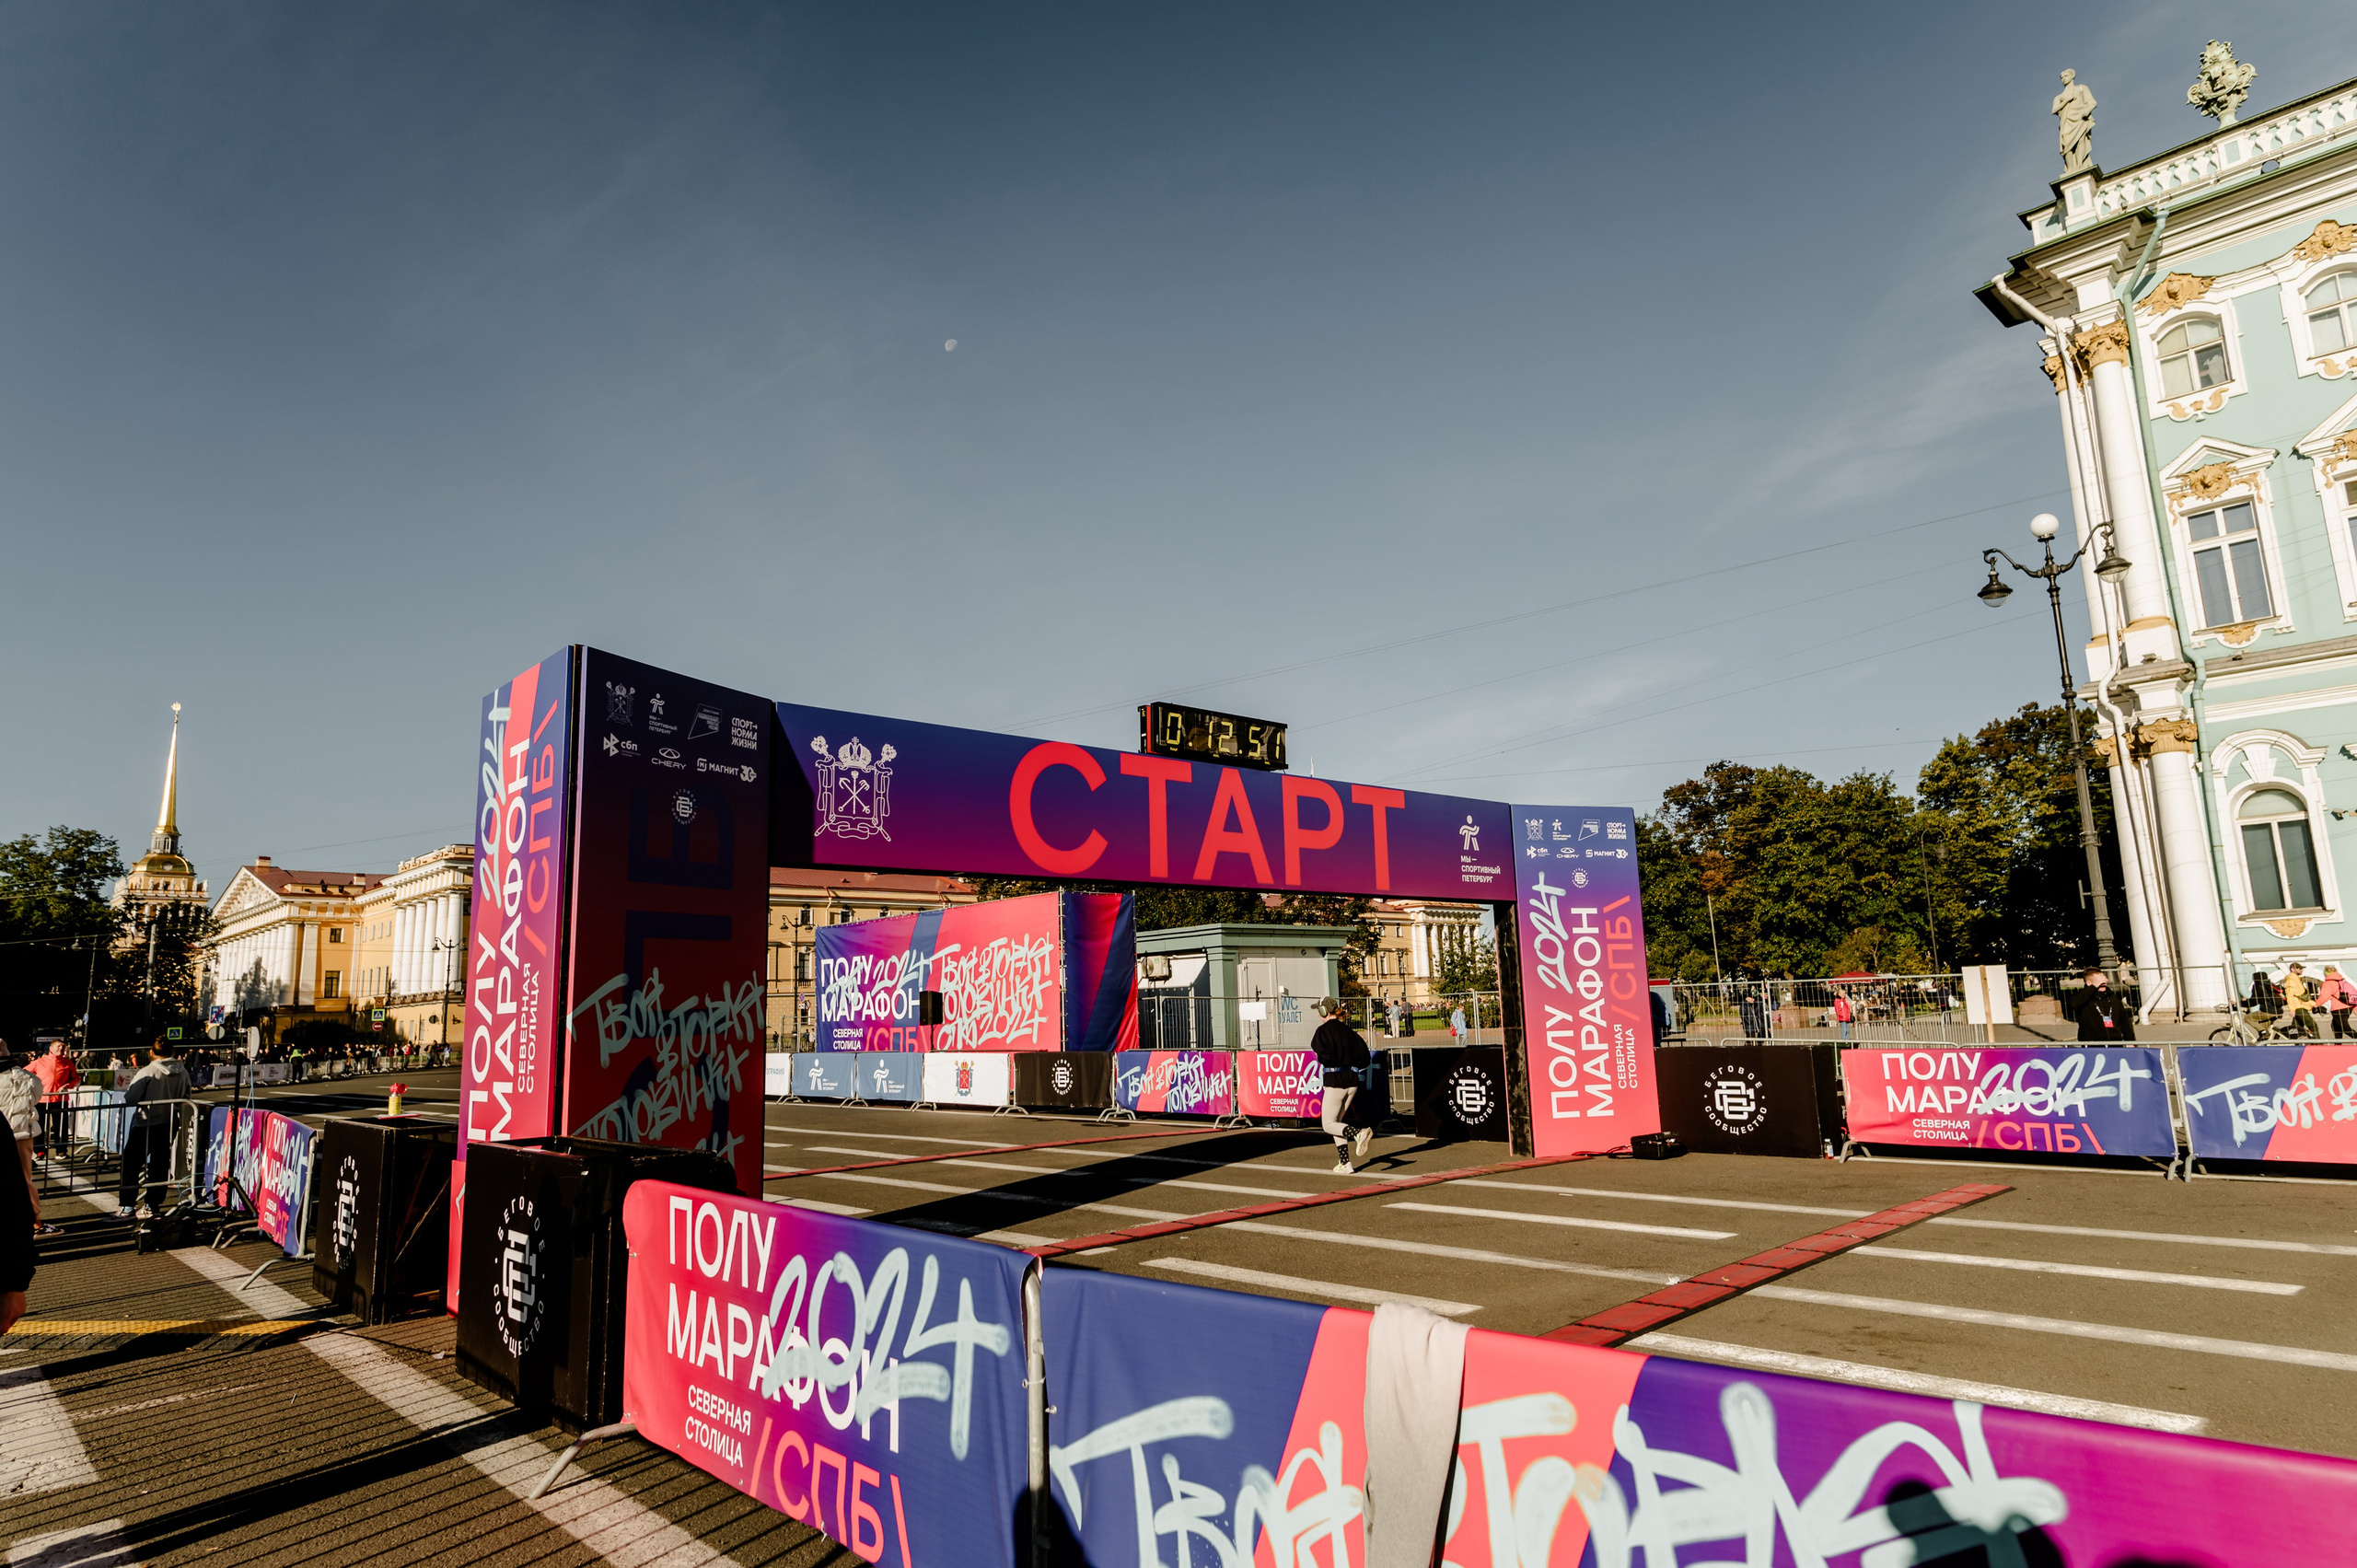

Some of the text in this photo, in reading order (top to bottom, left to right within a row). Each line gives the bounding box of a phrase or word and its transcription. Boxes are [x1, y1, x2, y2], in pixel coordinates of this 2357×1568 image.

[731, 716, 753, 730] СПОРТ
[731, 726, 758, 741] НОРМА
[731, 736, 758, 750] ЖИЗНИ
[651, 757, 687, 770] CHERY
[709, 763, 739, 776] МАГНИТ
[1009, 741, 1405, 891] СТАРТ
[1461, 865, 1501, 875] СПОРТИВНЫЙ
[1461, 875, 1493, 883] ПЕТЕРБУРГ
[467, 689, 512, 1142] ПОЛУ 2024
[489, 738, 530, 1142] МАРАФОН
[1529, 871, 1573, 994] 2024
[820, 948, 930, 997] ПОЛУ 2024
[1281, 996, 1298, 1010] WC
[1570, 907, 1615, 1118] МАРАФОН
[517, 962, 531, 1094] СЕВЕРНАЯ
[526, 970, 540, 1094] СТОЛИЦА
[832, 1028, 864, 1039] СЕВЕРНАЯ
[977, 1009, 1048, 1045] 2024
[832, 1040, 862, 1051] СТОЛИЦА
[1613, 1024, 1627, 1089] СЕВЕРНАЯ
[1623, 1028, 1638, 1089] СТОЛИЦА
[1256, 1053, 1306, 1073] ПОЛУ
[1448, 1065, 1492, 1086] БЕГОВОЕ
[1544, 1005, 1581, 1120] ПОЛУ
[1704, 1065, 1762, 1088] БЕГОВОЕ
[1258, 1075, 1323, 1095] МАРАФ
[1881, 1051, 2152, 1114] ПОЛУ 2024
[1270, 1098, 1299, 1106] СЕВЕРНАЯ
[1270, 1105, 1297, 1113] СТОЛИЦА
[1448, 1099, 1495, 1125] СООБЩЕСТВО
[1886, 1086, 2086, 1117] МАРАФОН
[1704, 1106, 1767, 1135] СООБЩЕСТВО
[1912, 1118, 1970, 1130] СЕВЕРНАЯ
[1913, 1129, 1968, 1142] СТОЛИЦА
[497, 1196, 546, 1252] БЕГОВОЕ
[493, 1283, 544, 1358] СООБЩЕСТВО
[668, 1195, 1010, 1461] ПОЛУ 2024
[667, 1282, 900, 1454] МАРАФОН
[686, 1384, 752, 1436] СЕВЕРНАЯ
[684, 1414, 744, 1469] СТОЛИЦА
